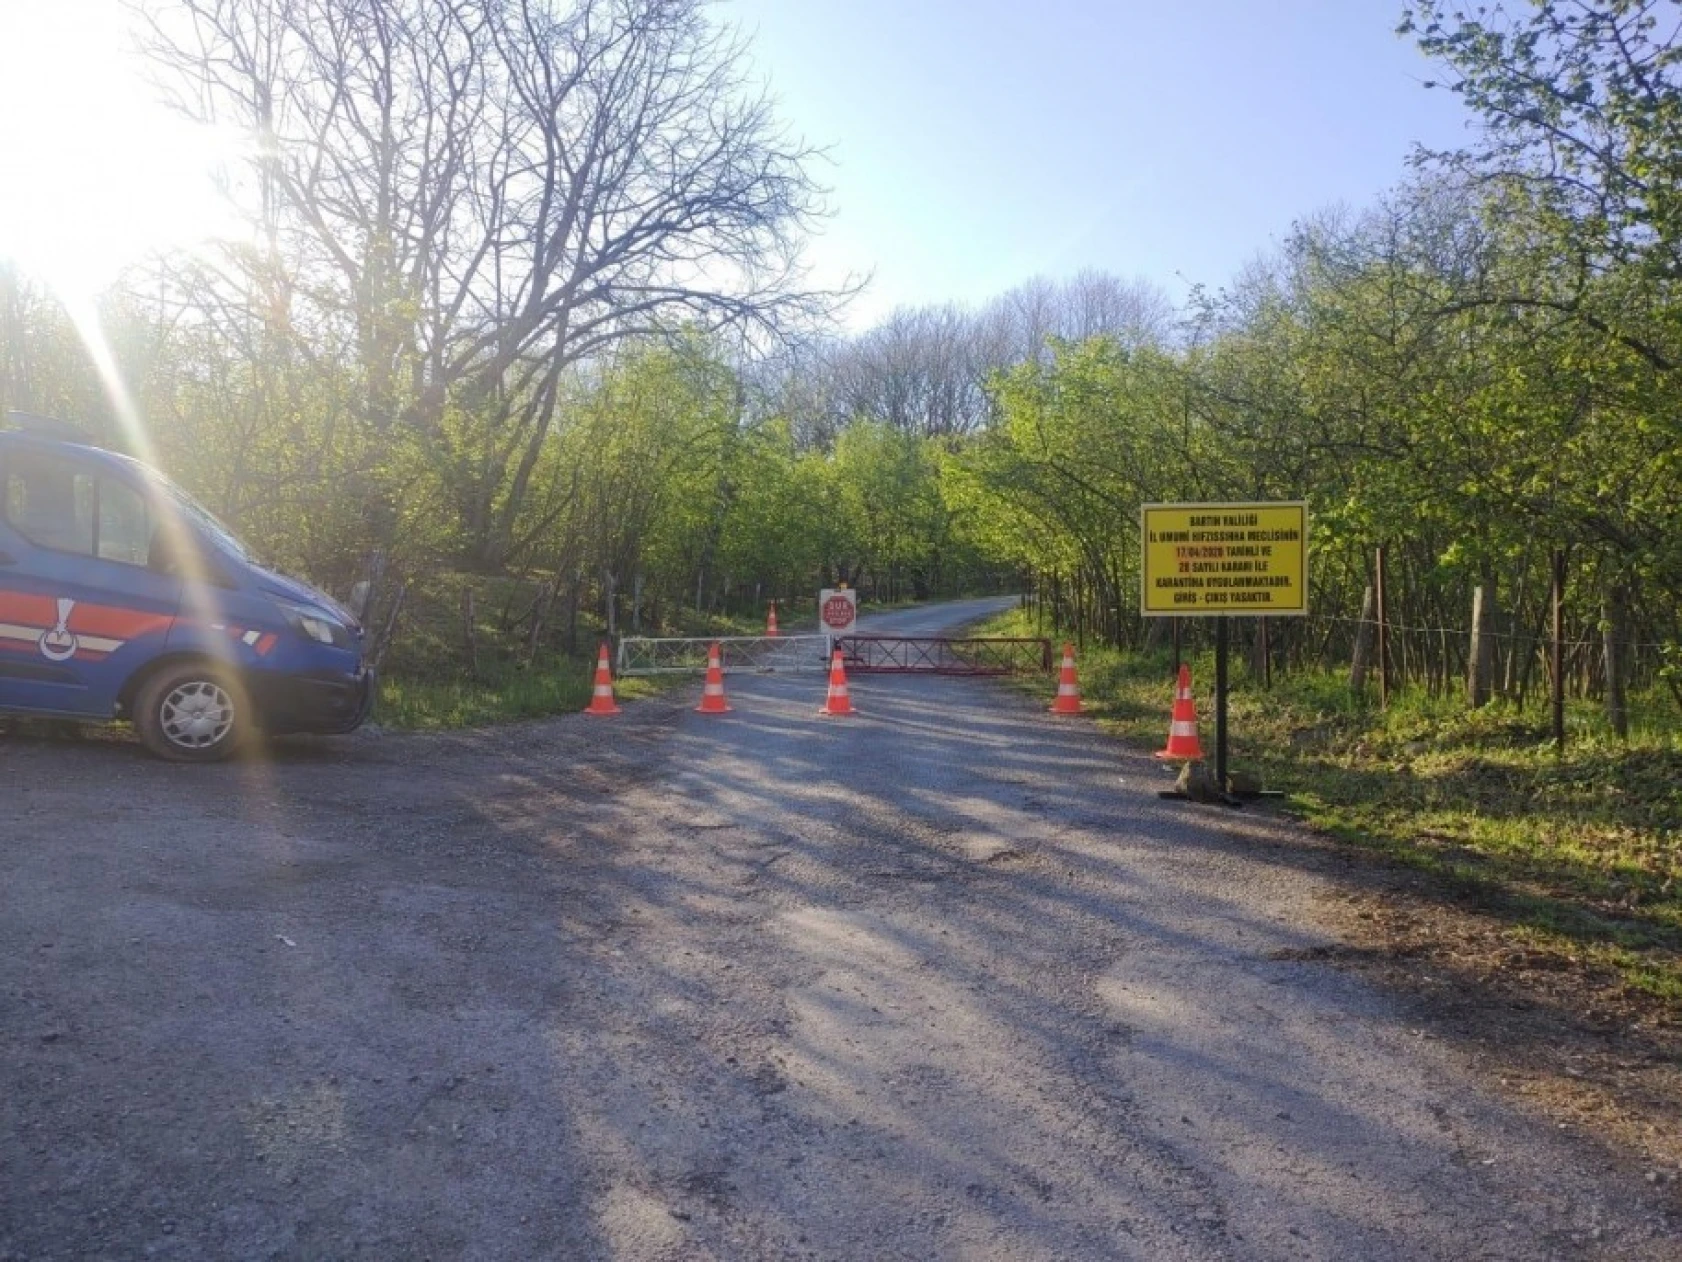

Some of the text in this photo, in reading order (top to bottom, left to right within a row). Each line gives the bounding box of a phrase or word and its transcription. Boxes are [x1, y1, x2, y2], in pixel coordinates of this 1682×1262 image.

[1189, 516, 1221, 527] BARTIN
[1150, 530, 1158, 542] İL
[1262, 546, 1272, 556] VE
[1192, 562, 1219, 573] SAYILI
[1221, 561, 1253, 572] KARARI
[1255, 561, 1269, 572] İLE
[1174, 592, 1197, 604] GİRİŞ
